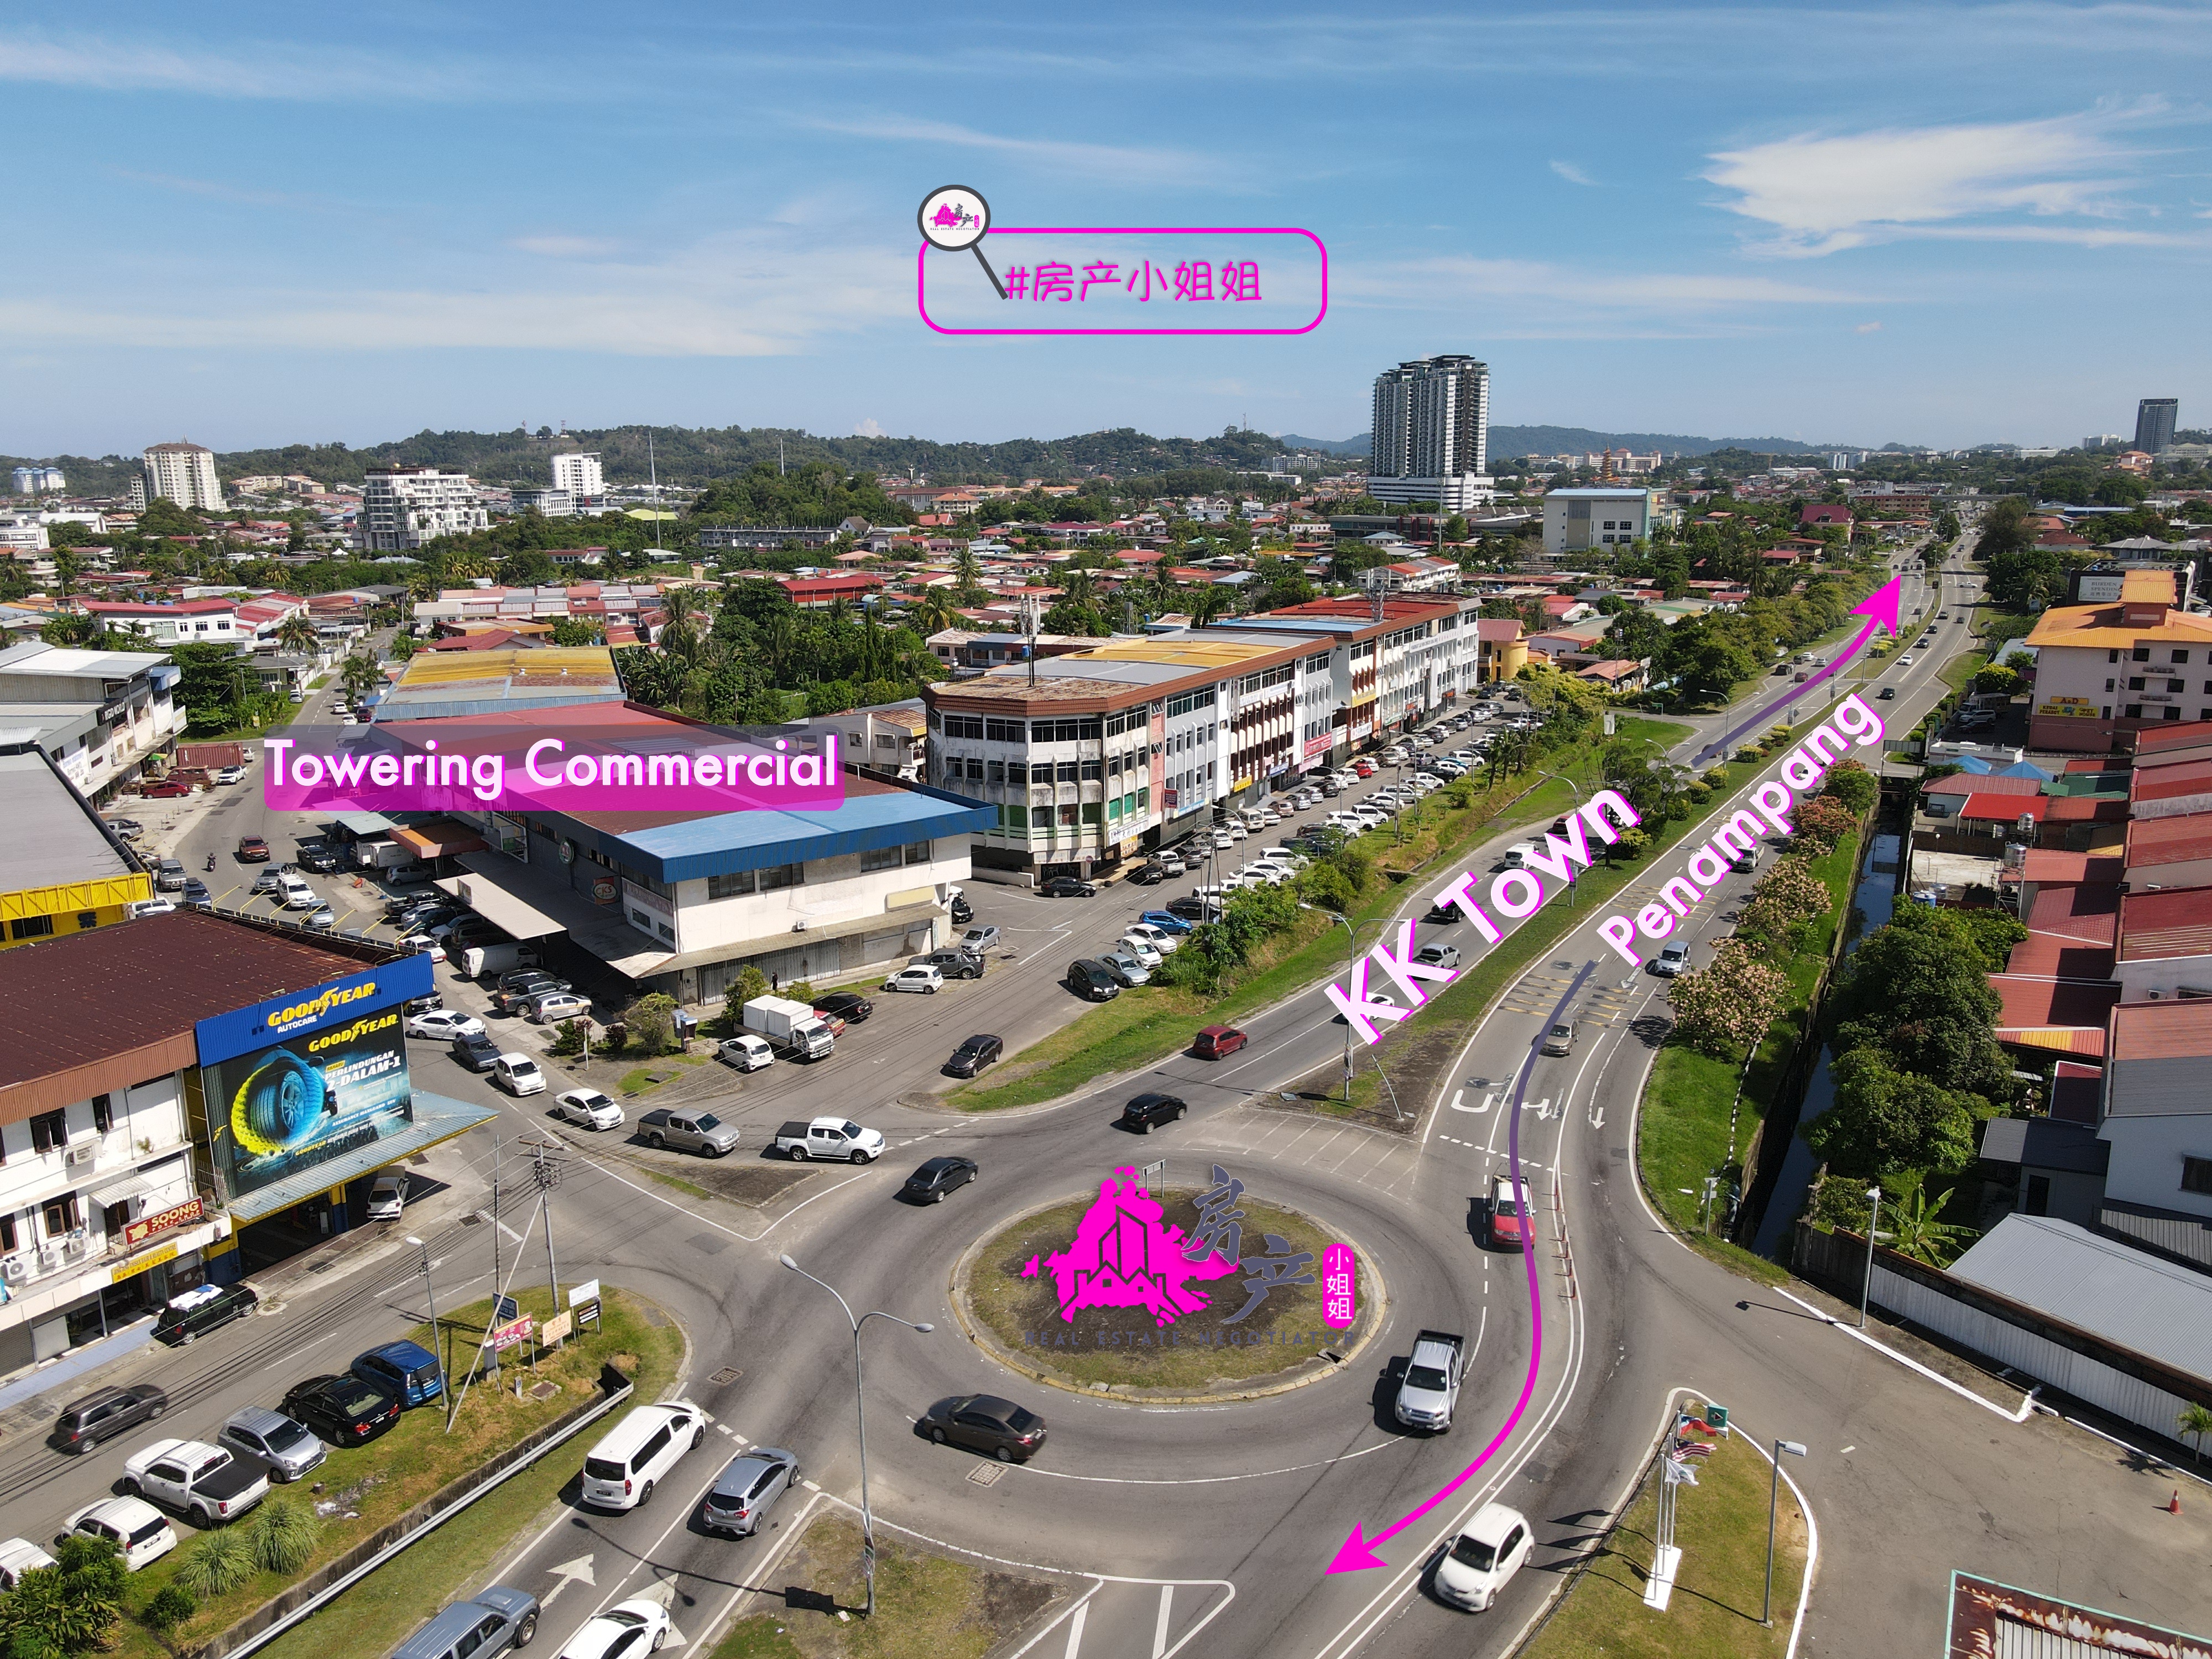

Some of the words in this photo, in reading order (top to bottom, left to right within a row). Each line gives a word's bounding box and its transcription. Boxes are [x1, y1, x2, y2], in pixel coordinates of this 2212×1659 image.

[596, 885, 612, 895] CKS
[268, 982, 376, 1027] GOODYEAR
[277, 1015, 317, 1034] AUTOCARE
[309, 1014, 398, 1052] GOODYEAR
[325, 1050, 394, 1081] PERLINDUNGAN
[326, 1056, 400, 1092] 2-DALAM-1
[152, 1201, 199, 1227] SOONG
